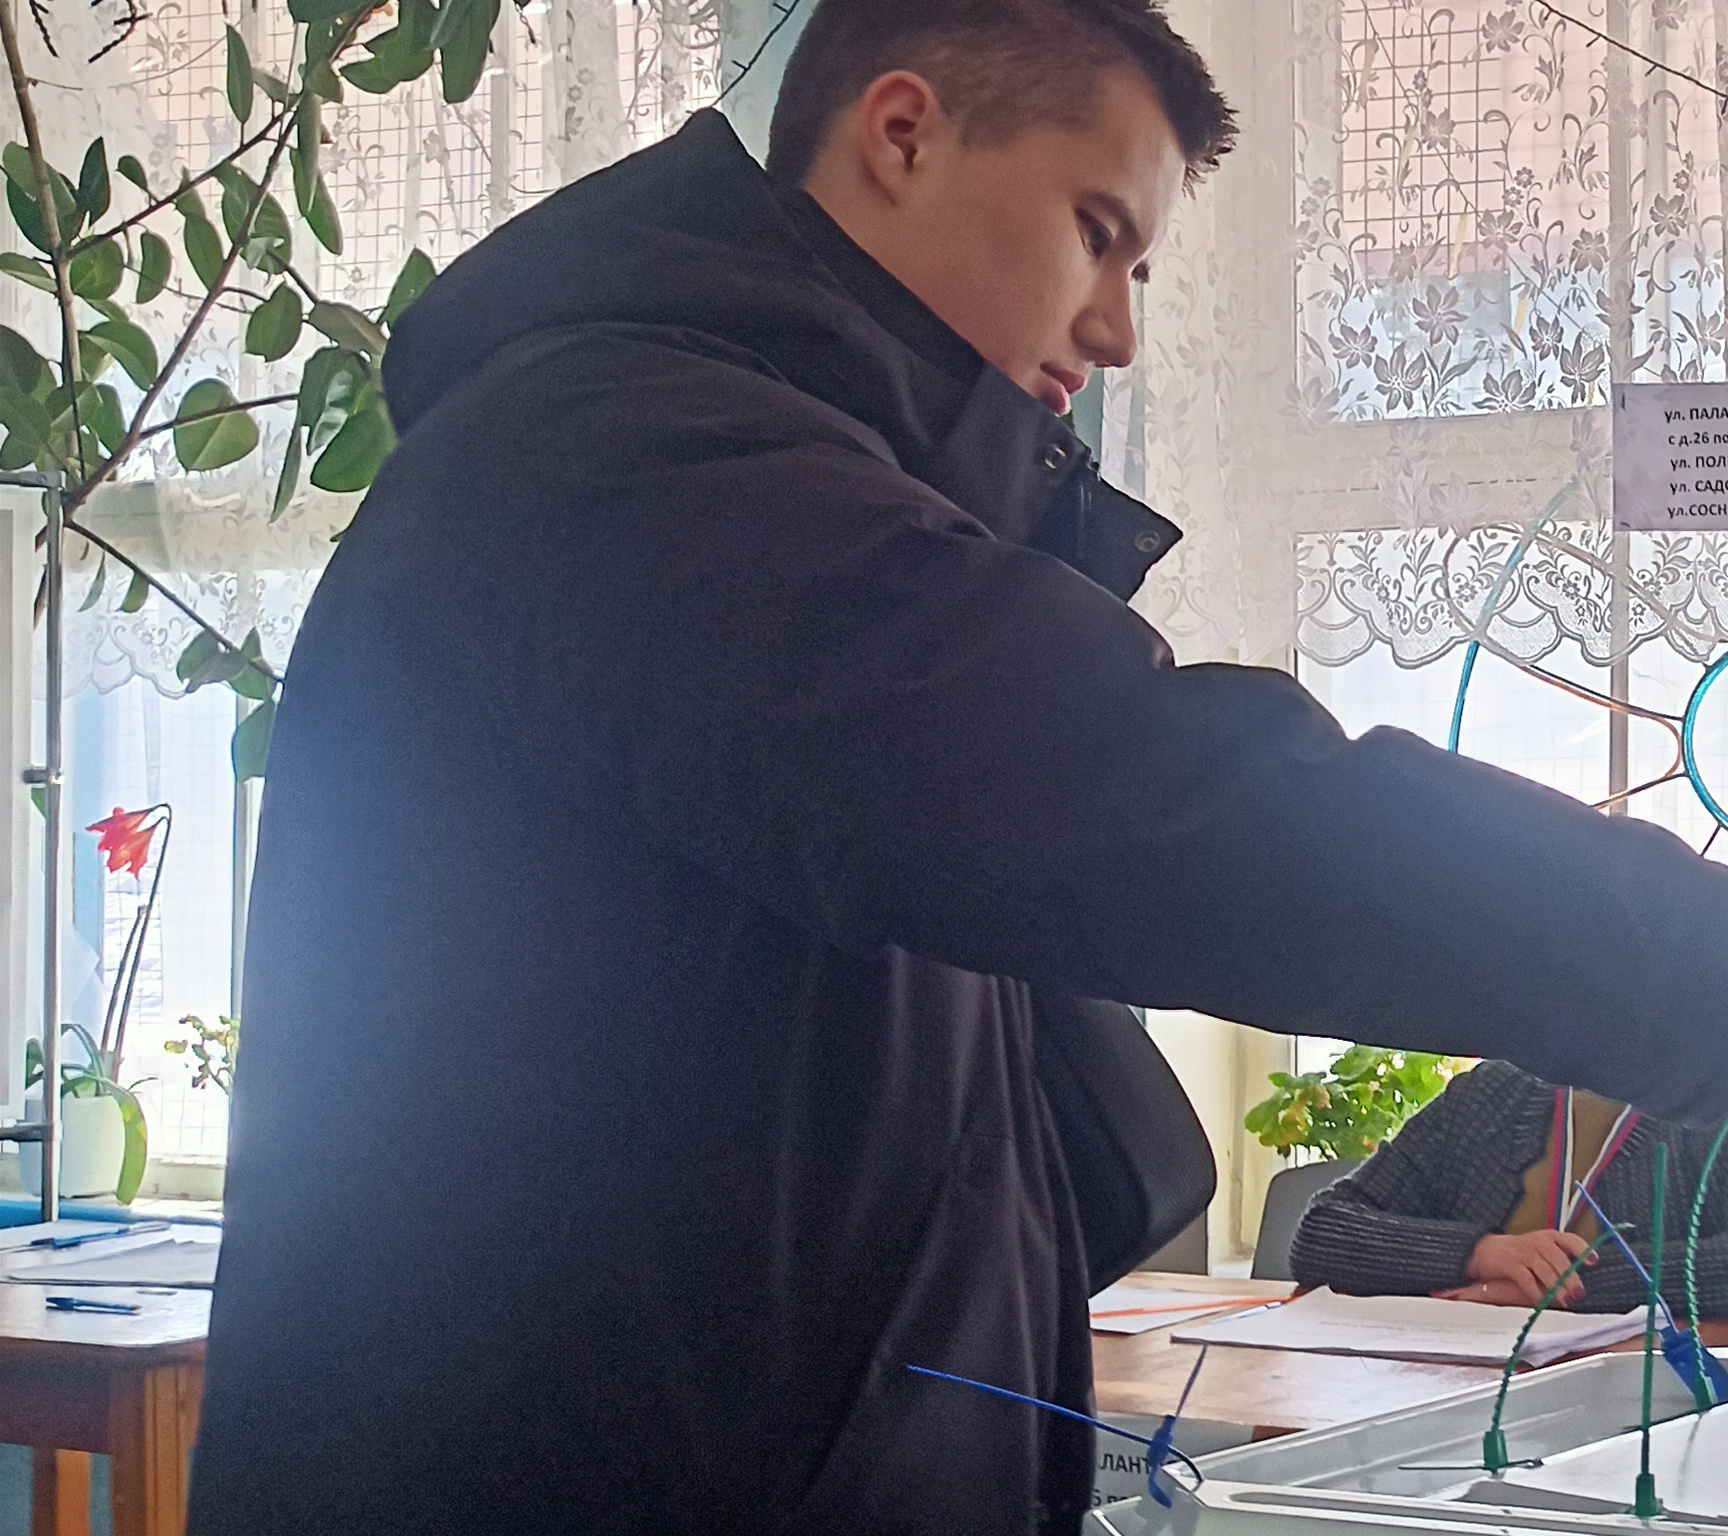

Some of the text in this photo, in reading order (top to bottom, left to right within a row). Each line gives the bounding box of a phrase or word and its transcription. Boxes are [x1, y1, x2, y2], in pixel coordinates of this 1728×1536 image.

[1664, 409, 1686, 424] ул.
[1668, 434, 1676, 445] с
[1678, 431, 1710, 447] д.26
[1669, 457, 1691, 472] ул.
[1669, 482, 1691, 496] ул.
